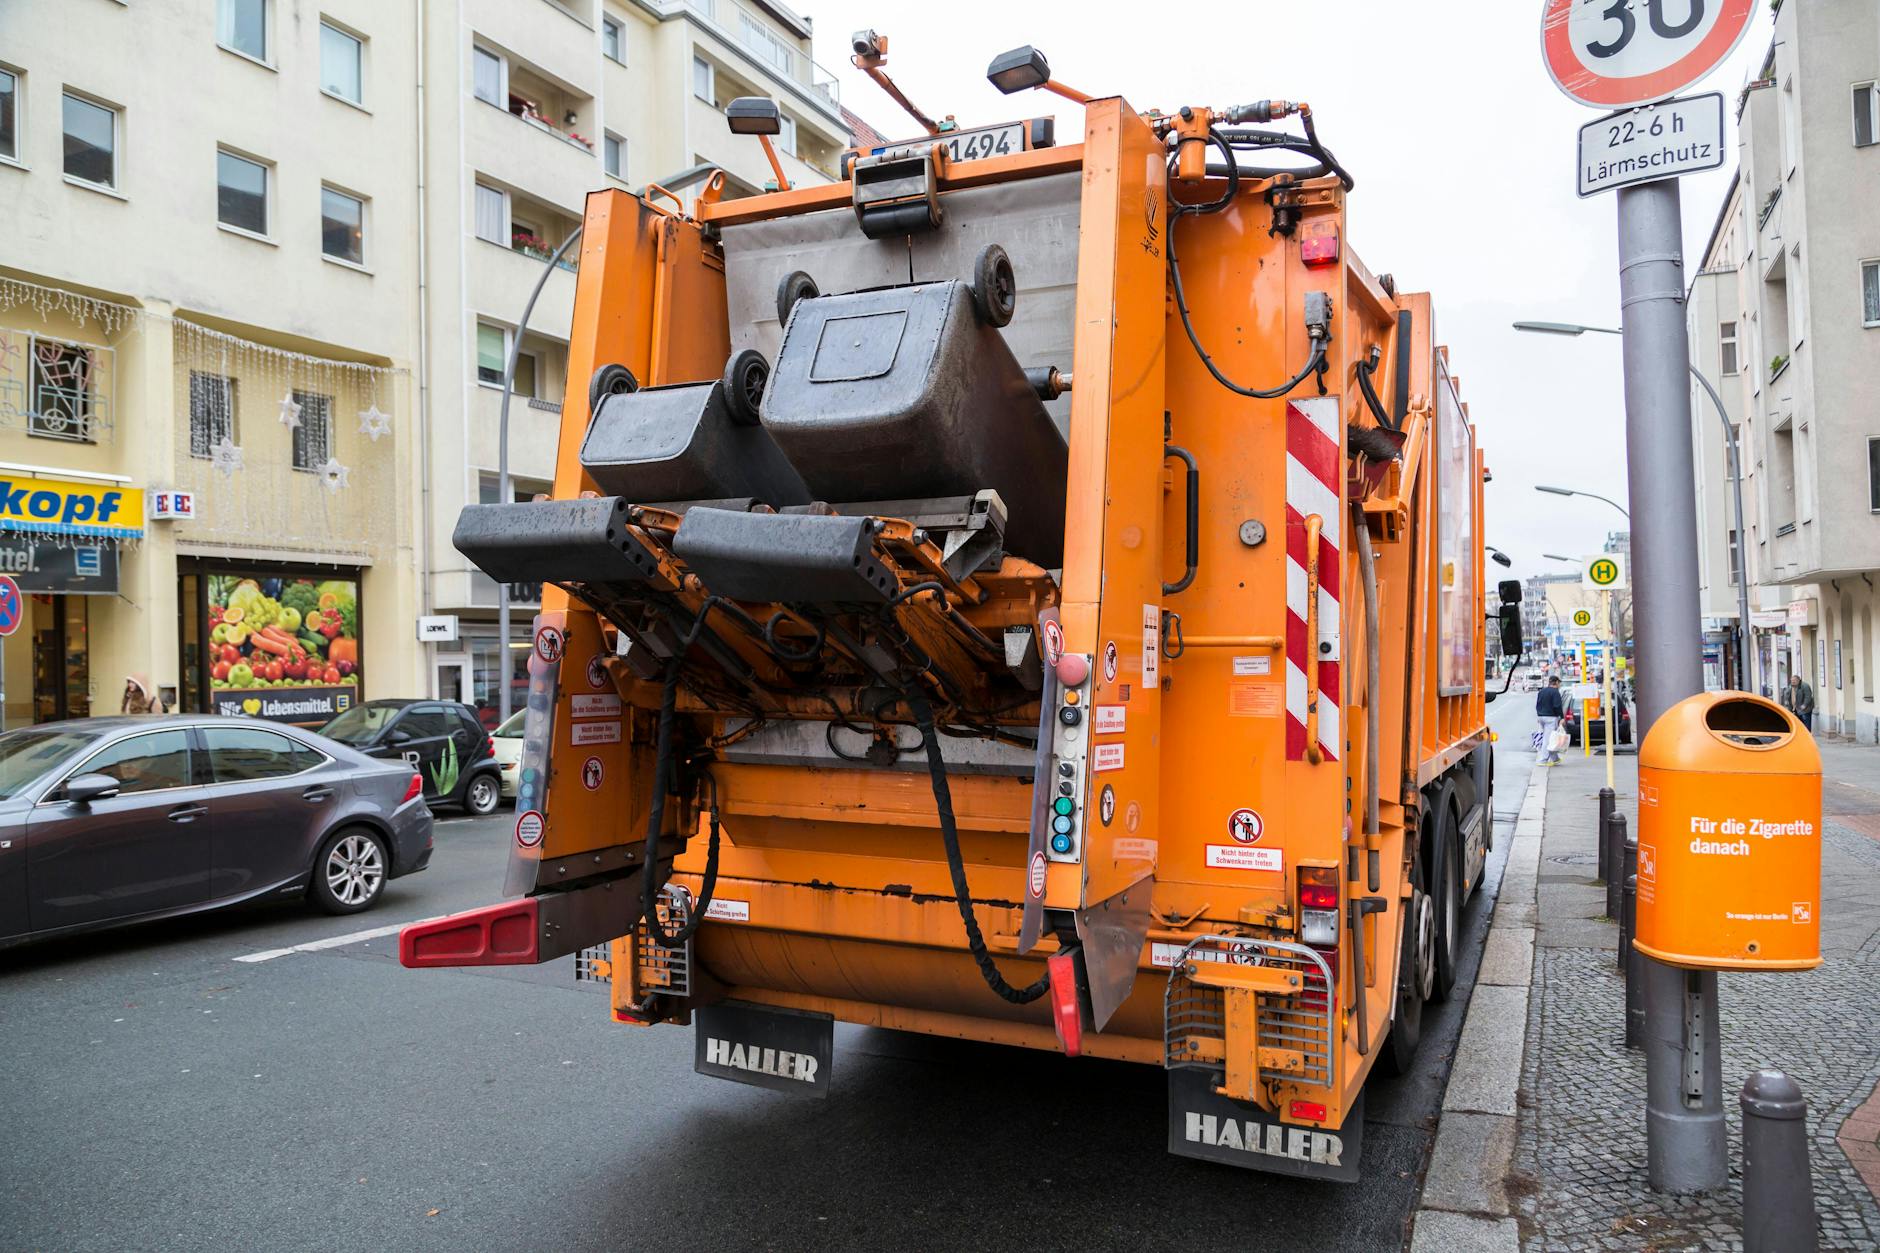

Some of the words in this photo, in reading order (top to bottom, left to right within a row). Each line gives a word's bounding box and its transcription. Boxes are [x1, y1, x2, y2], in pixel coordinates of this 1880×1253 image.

[1608, 115, 1664, 148] 22-6
[1672, 112, 1684, 133] h
[949, 131, 1010, 162] 1494
[1587, 143, 1711, 183] Lärmschutz
[263, 697, 334, 716] Lebensmittel.
[1690, 816, 1717, 834] Für
[1720, 818, 1745, 835] die
[1749, 819, 1813, 839] Zigarette
[1221, 849, 1237, 857] Nicht
[1690, 837, 1750, 855] danach
[706, 1037, 819, 1083] HALLER
[1185, 1111, 1343, 1167] HALLER
